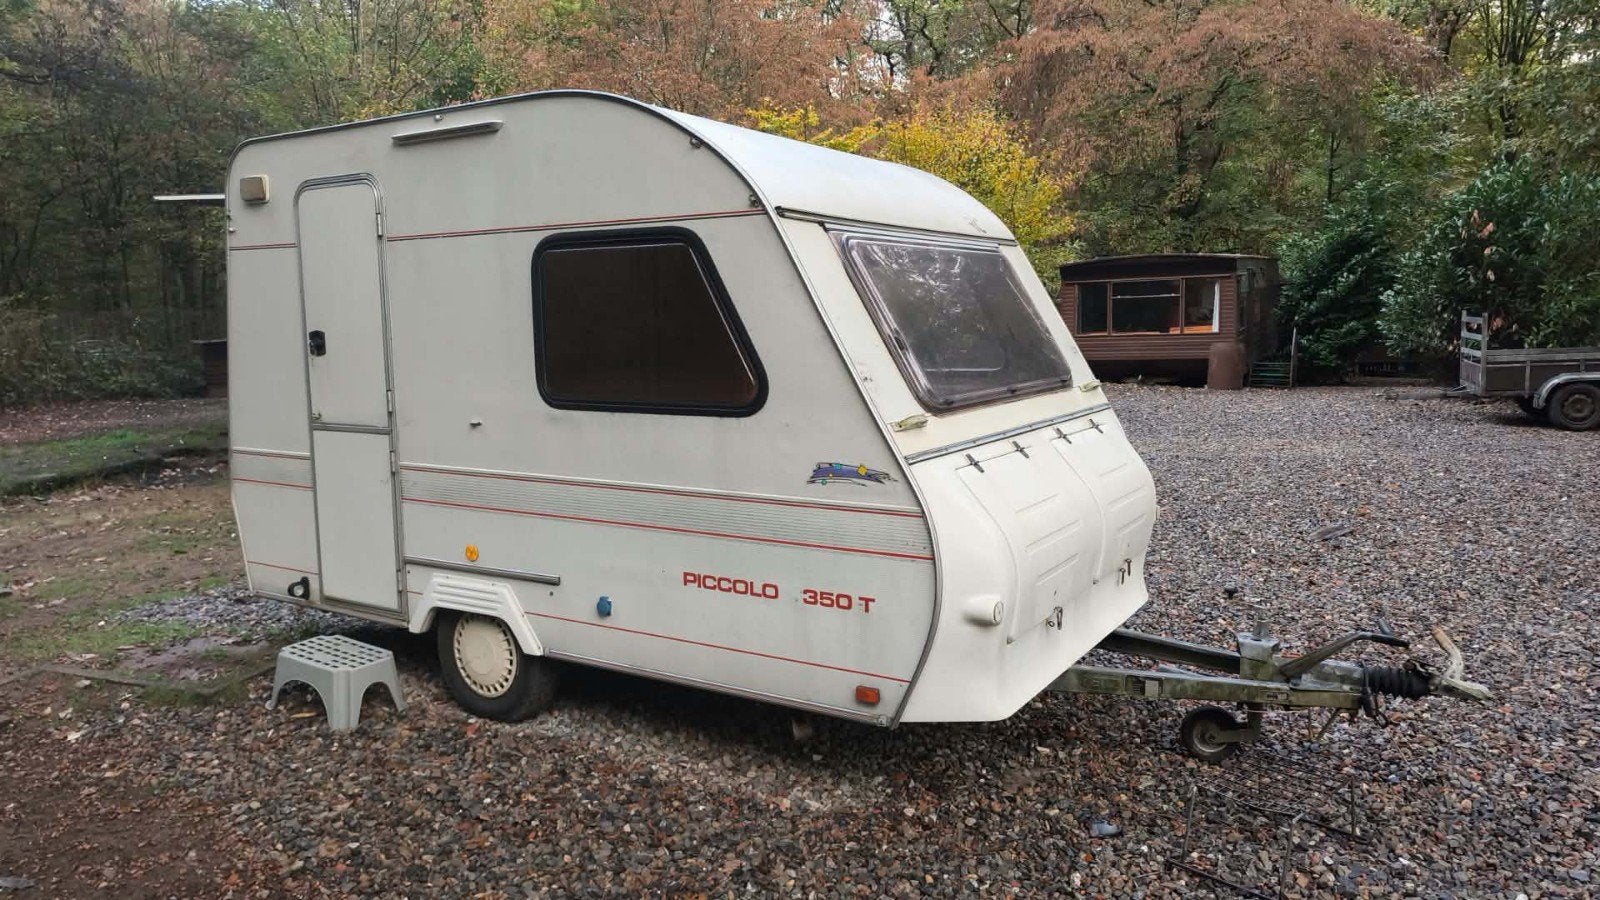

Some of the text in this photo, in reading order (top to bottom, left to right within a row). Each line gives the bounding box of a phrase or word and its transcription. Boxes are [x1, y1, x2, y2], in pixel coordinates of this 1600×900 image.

[683, 572, 876, 613] PICCOLO 350 T
